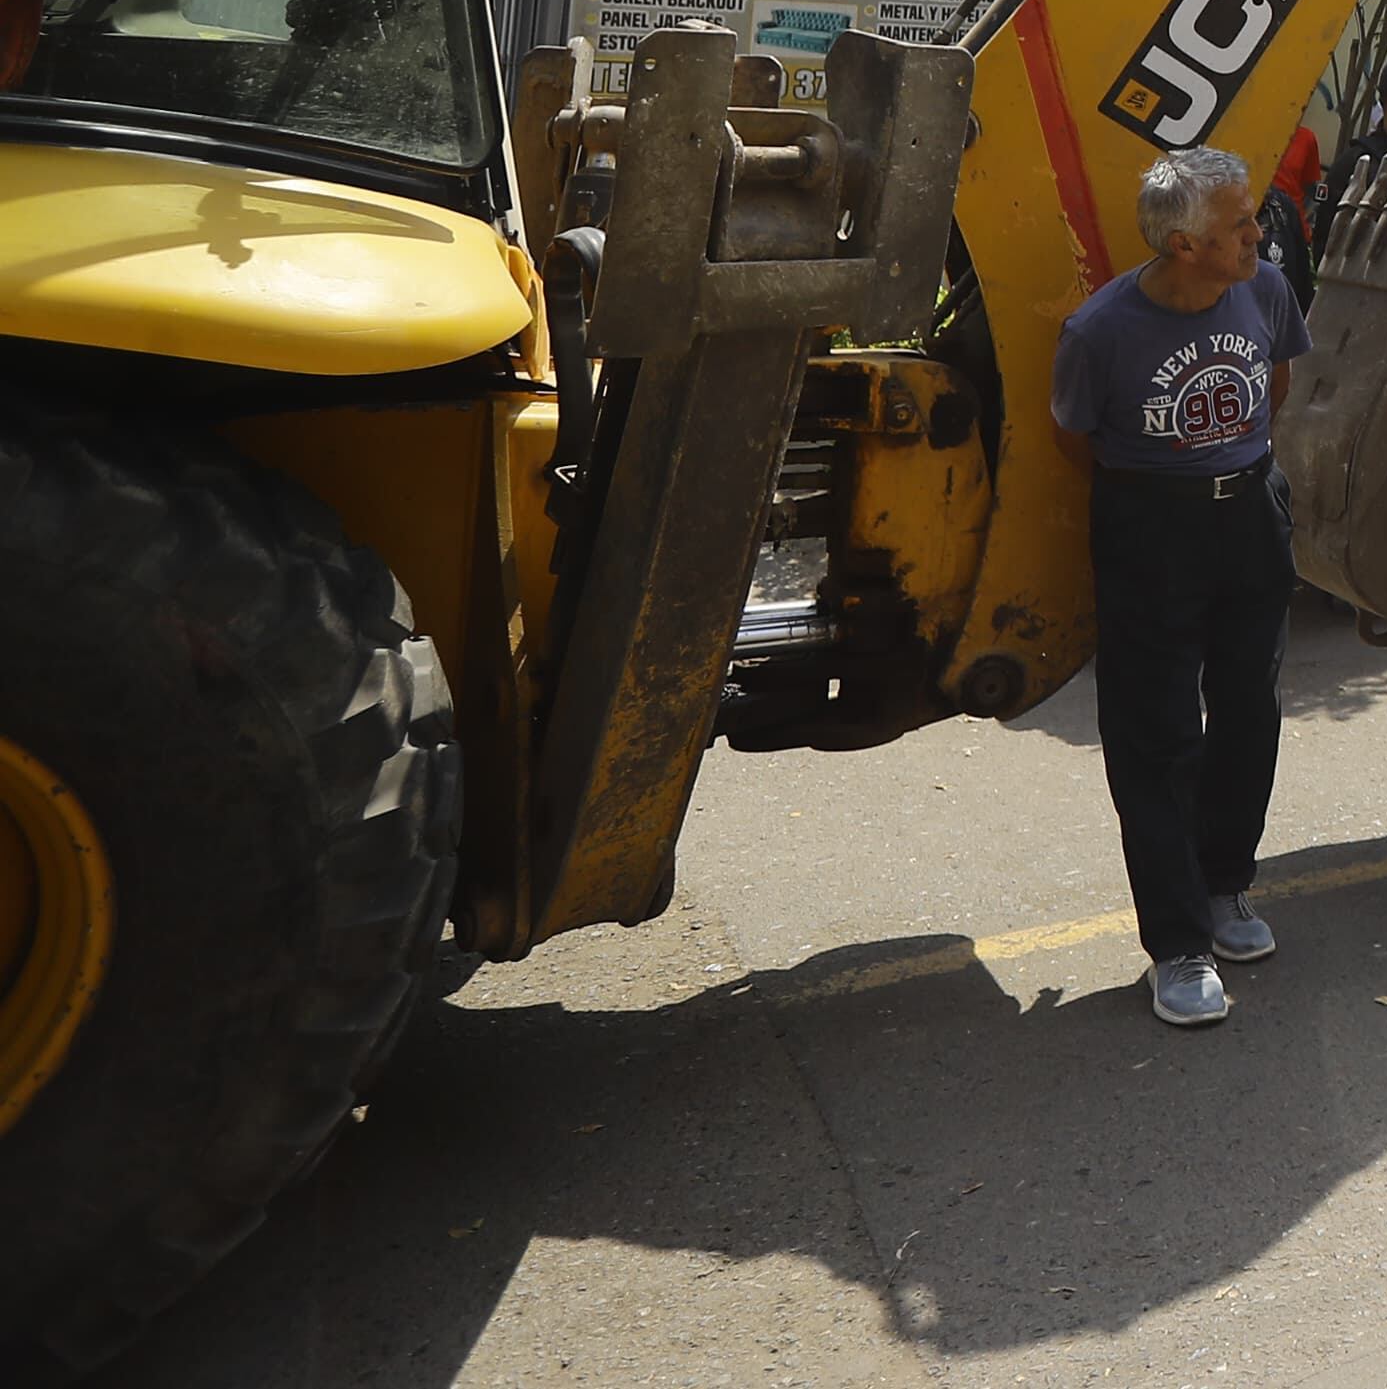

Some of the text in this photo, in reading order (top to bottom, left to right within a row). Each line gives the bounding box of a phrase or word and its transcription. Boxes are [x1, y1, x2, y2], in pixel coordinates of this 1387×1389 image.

[601, 11, 649, 29] PANEL
[879, 4, 925, 21] METAL
[929, 6, 938, 21] Y
[598, 34, 643, 51] ESTO
[591, 60, 633, 93] TE
[1151, 332, 1259, 390] NEW YORK
[1199, 371, 1224, 391] NYC
[1183, 381, 1242, 435] 96
[1143, 409, 1168, 432] N
